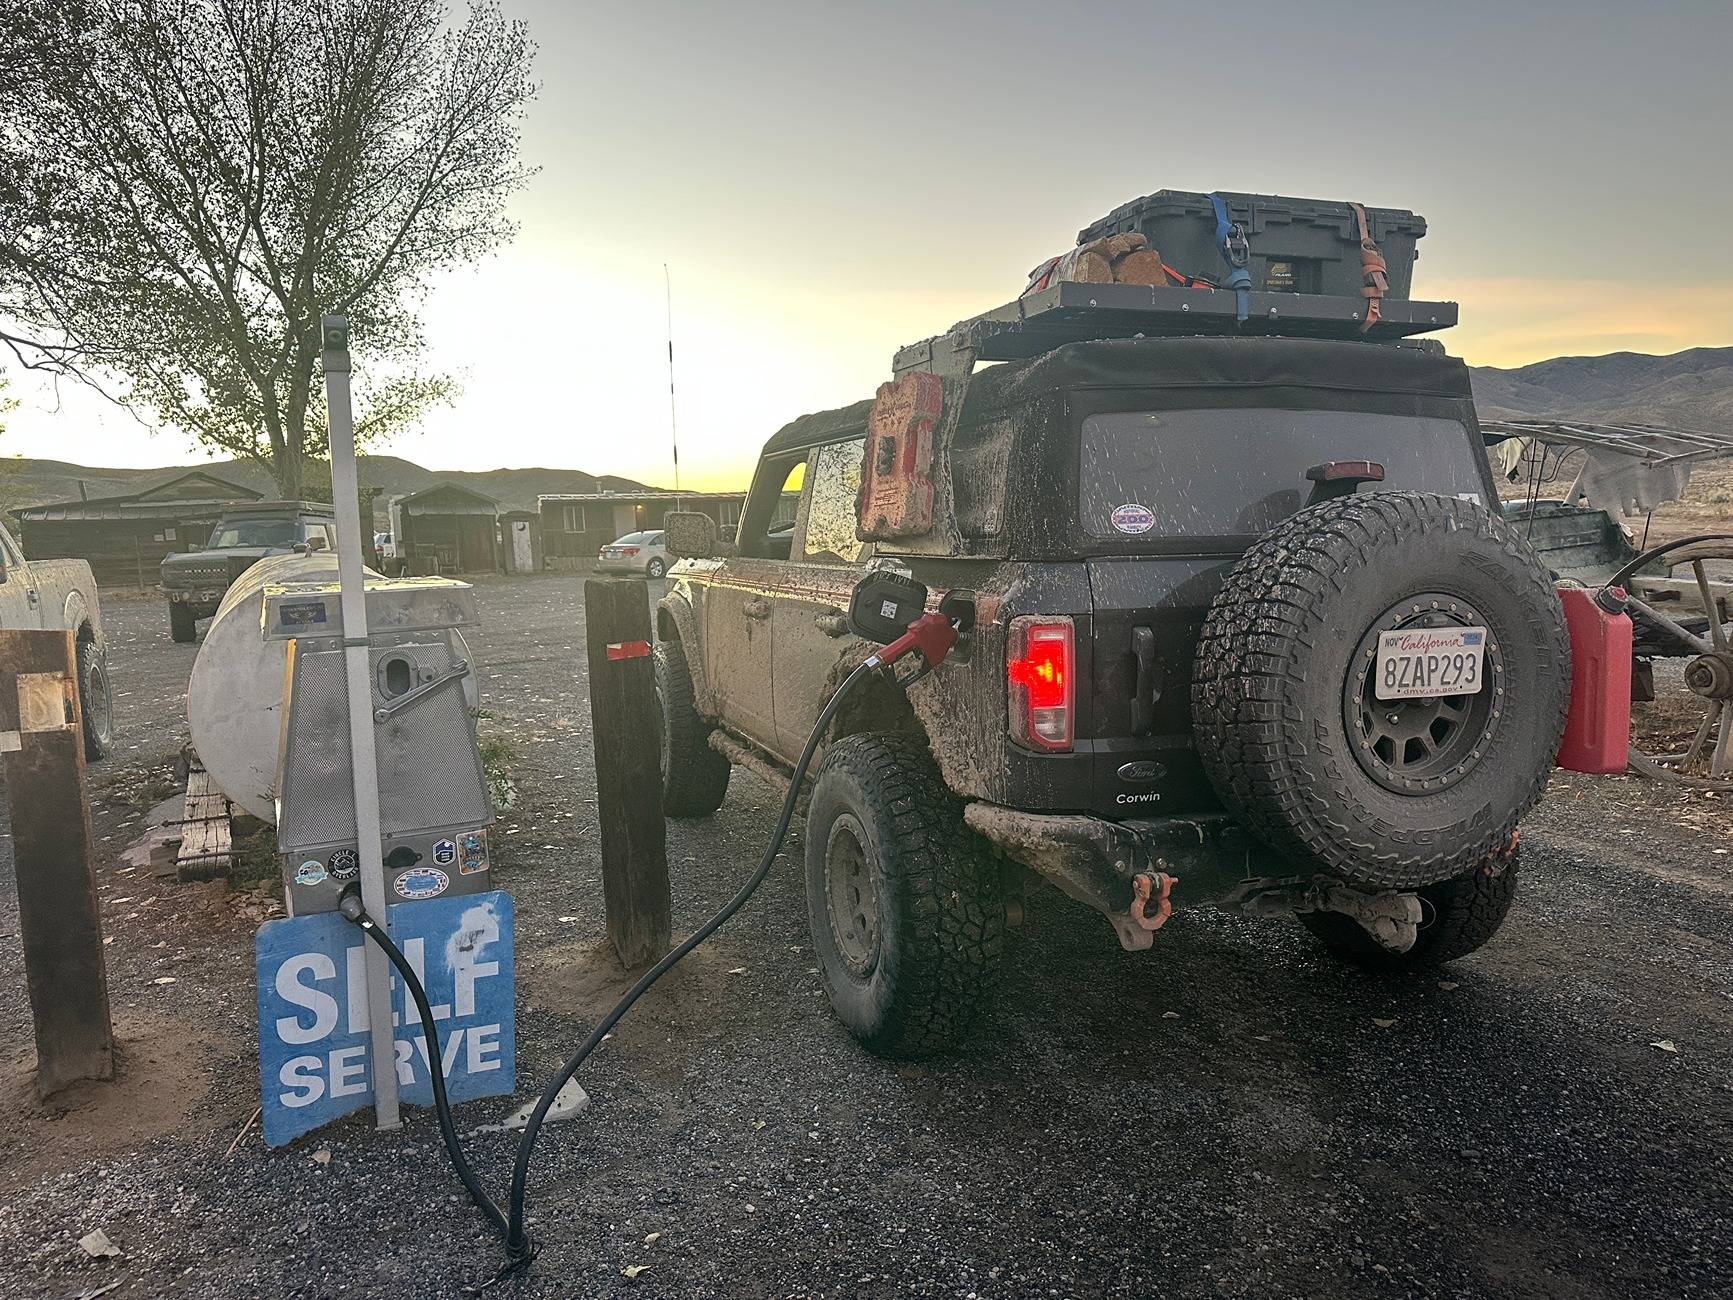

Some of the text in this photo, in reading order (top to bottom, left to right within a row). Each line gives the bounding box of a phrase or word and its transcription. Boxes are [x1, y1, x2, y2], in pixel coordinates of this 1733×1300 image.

[1385, 637, 1398, 648] NOV
[1400, 633, 1464, 654] California
[1384, 653, 1477, 688] 8ZAP293
[1403, 686, 1458, 695] dmv.ca.gov
[1116, 791, 1160, 804] Corwin
